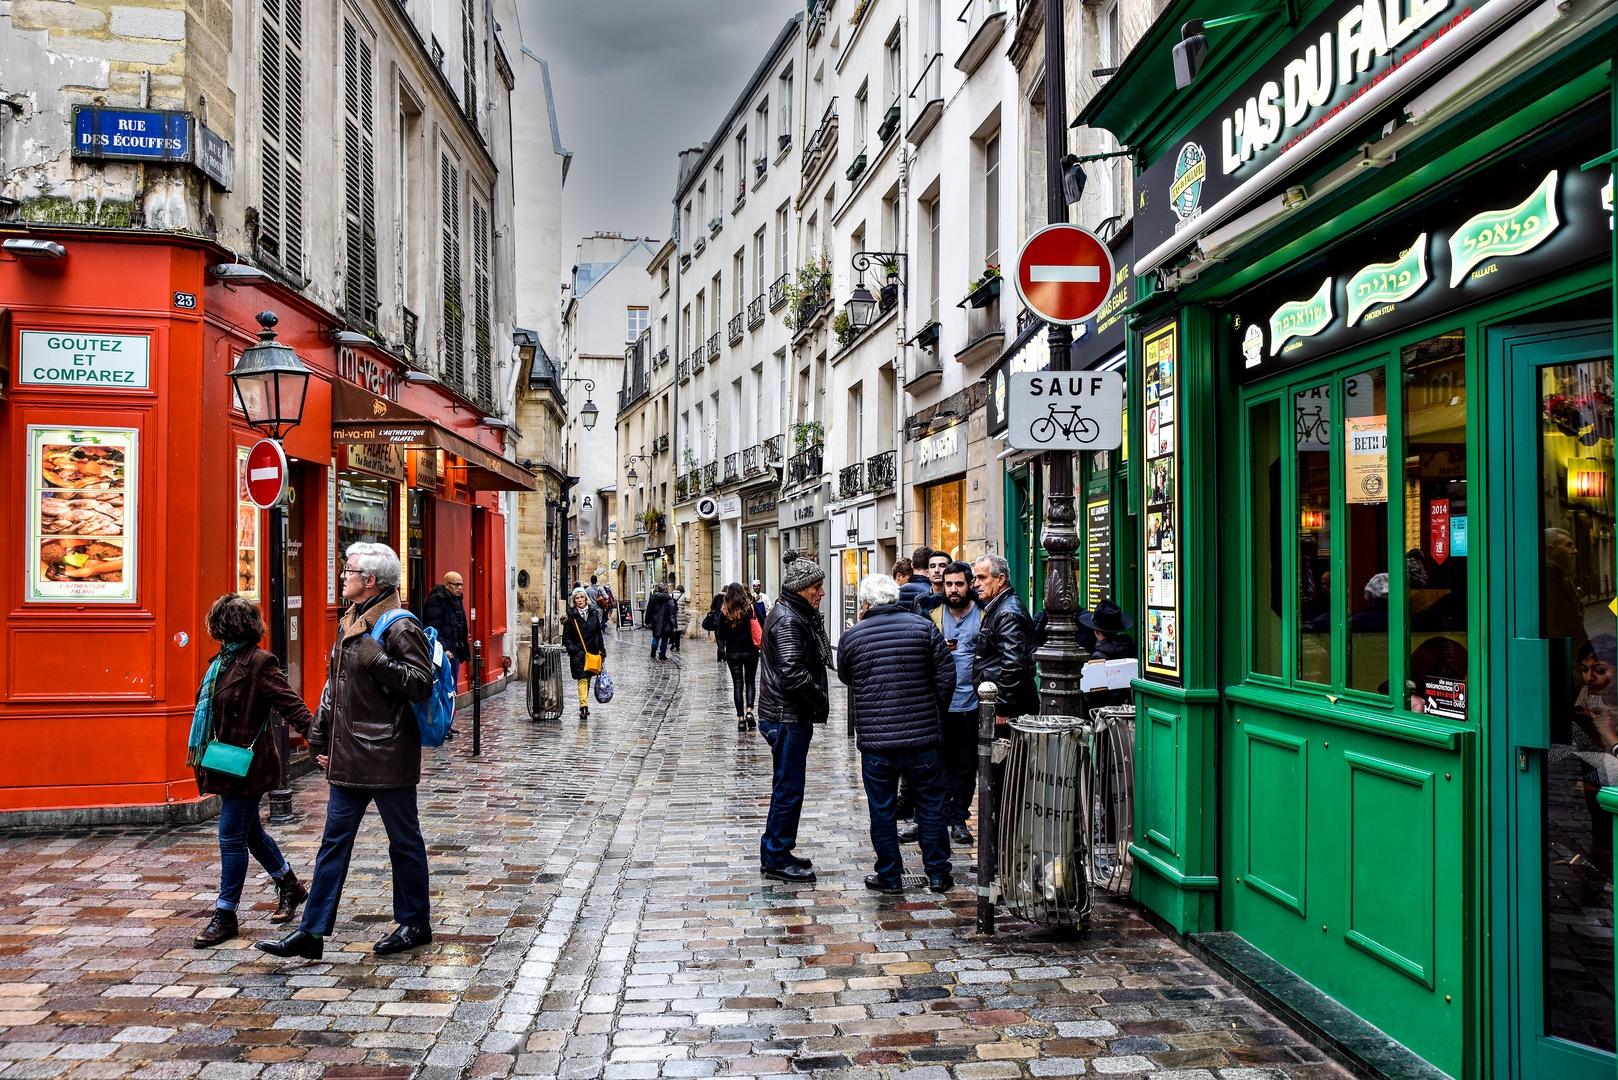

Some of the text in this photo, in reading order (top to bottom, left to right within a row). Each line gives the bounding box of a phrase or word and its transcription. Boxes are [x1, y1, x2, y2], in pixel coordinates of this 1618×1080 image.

[1222, 81, 1282, 175] L'AS
[1284, 32, 1333, 127] DU
[118, 119, 146, 132] RUE
[82, 133, 182, 150] DES ÉCOUFFES
[208, 140, 222, 159] RUE
[1461, 215, 1541, 257] פלאפל
[1471, 263, 1499, 280] FALLAFEL
[1357, 270, 1412, 297] פרגית
[177, 294, 193, 306] 23
[1364, 303, 1396, 322] CHICKEN STEAK
[47, 337, 122, 352] GOUTEZ
[73, 354, 96, 366] ET
[33, 367, 135, 383] COMPAREZ
[1029, 377, 1103, 396] SAUF
[333, 428, 376, 439] mi-va-mi
[1431, 504, 1448, 515] 2014
